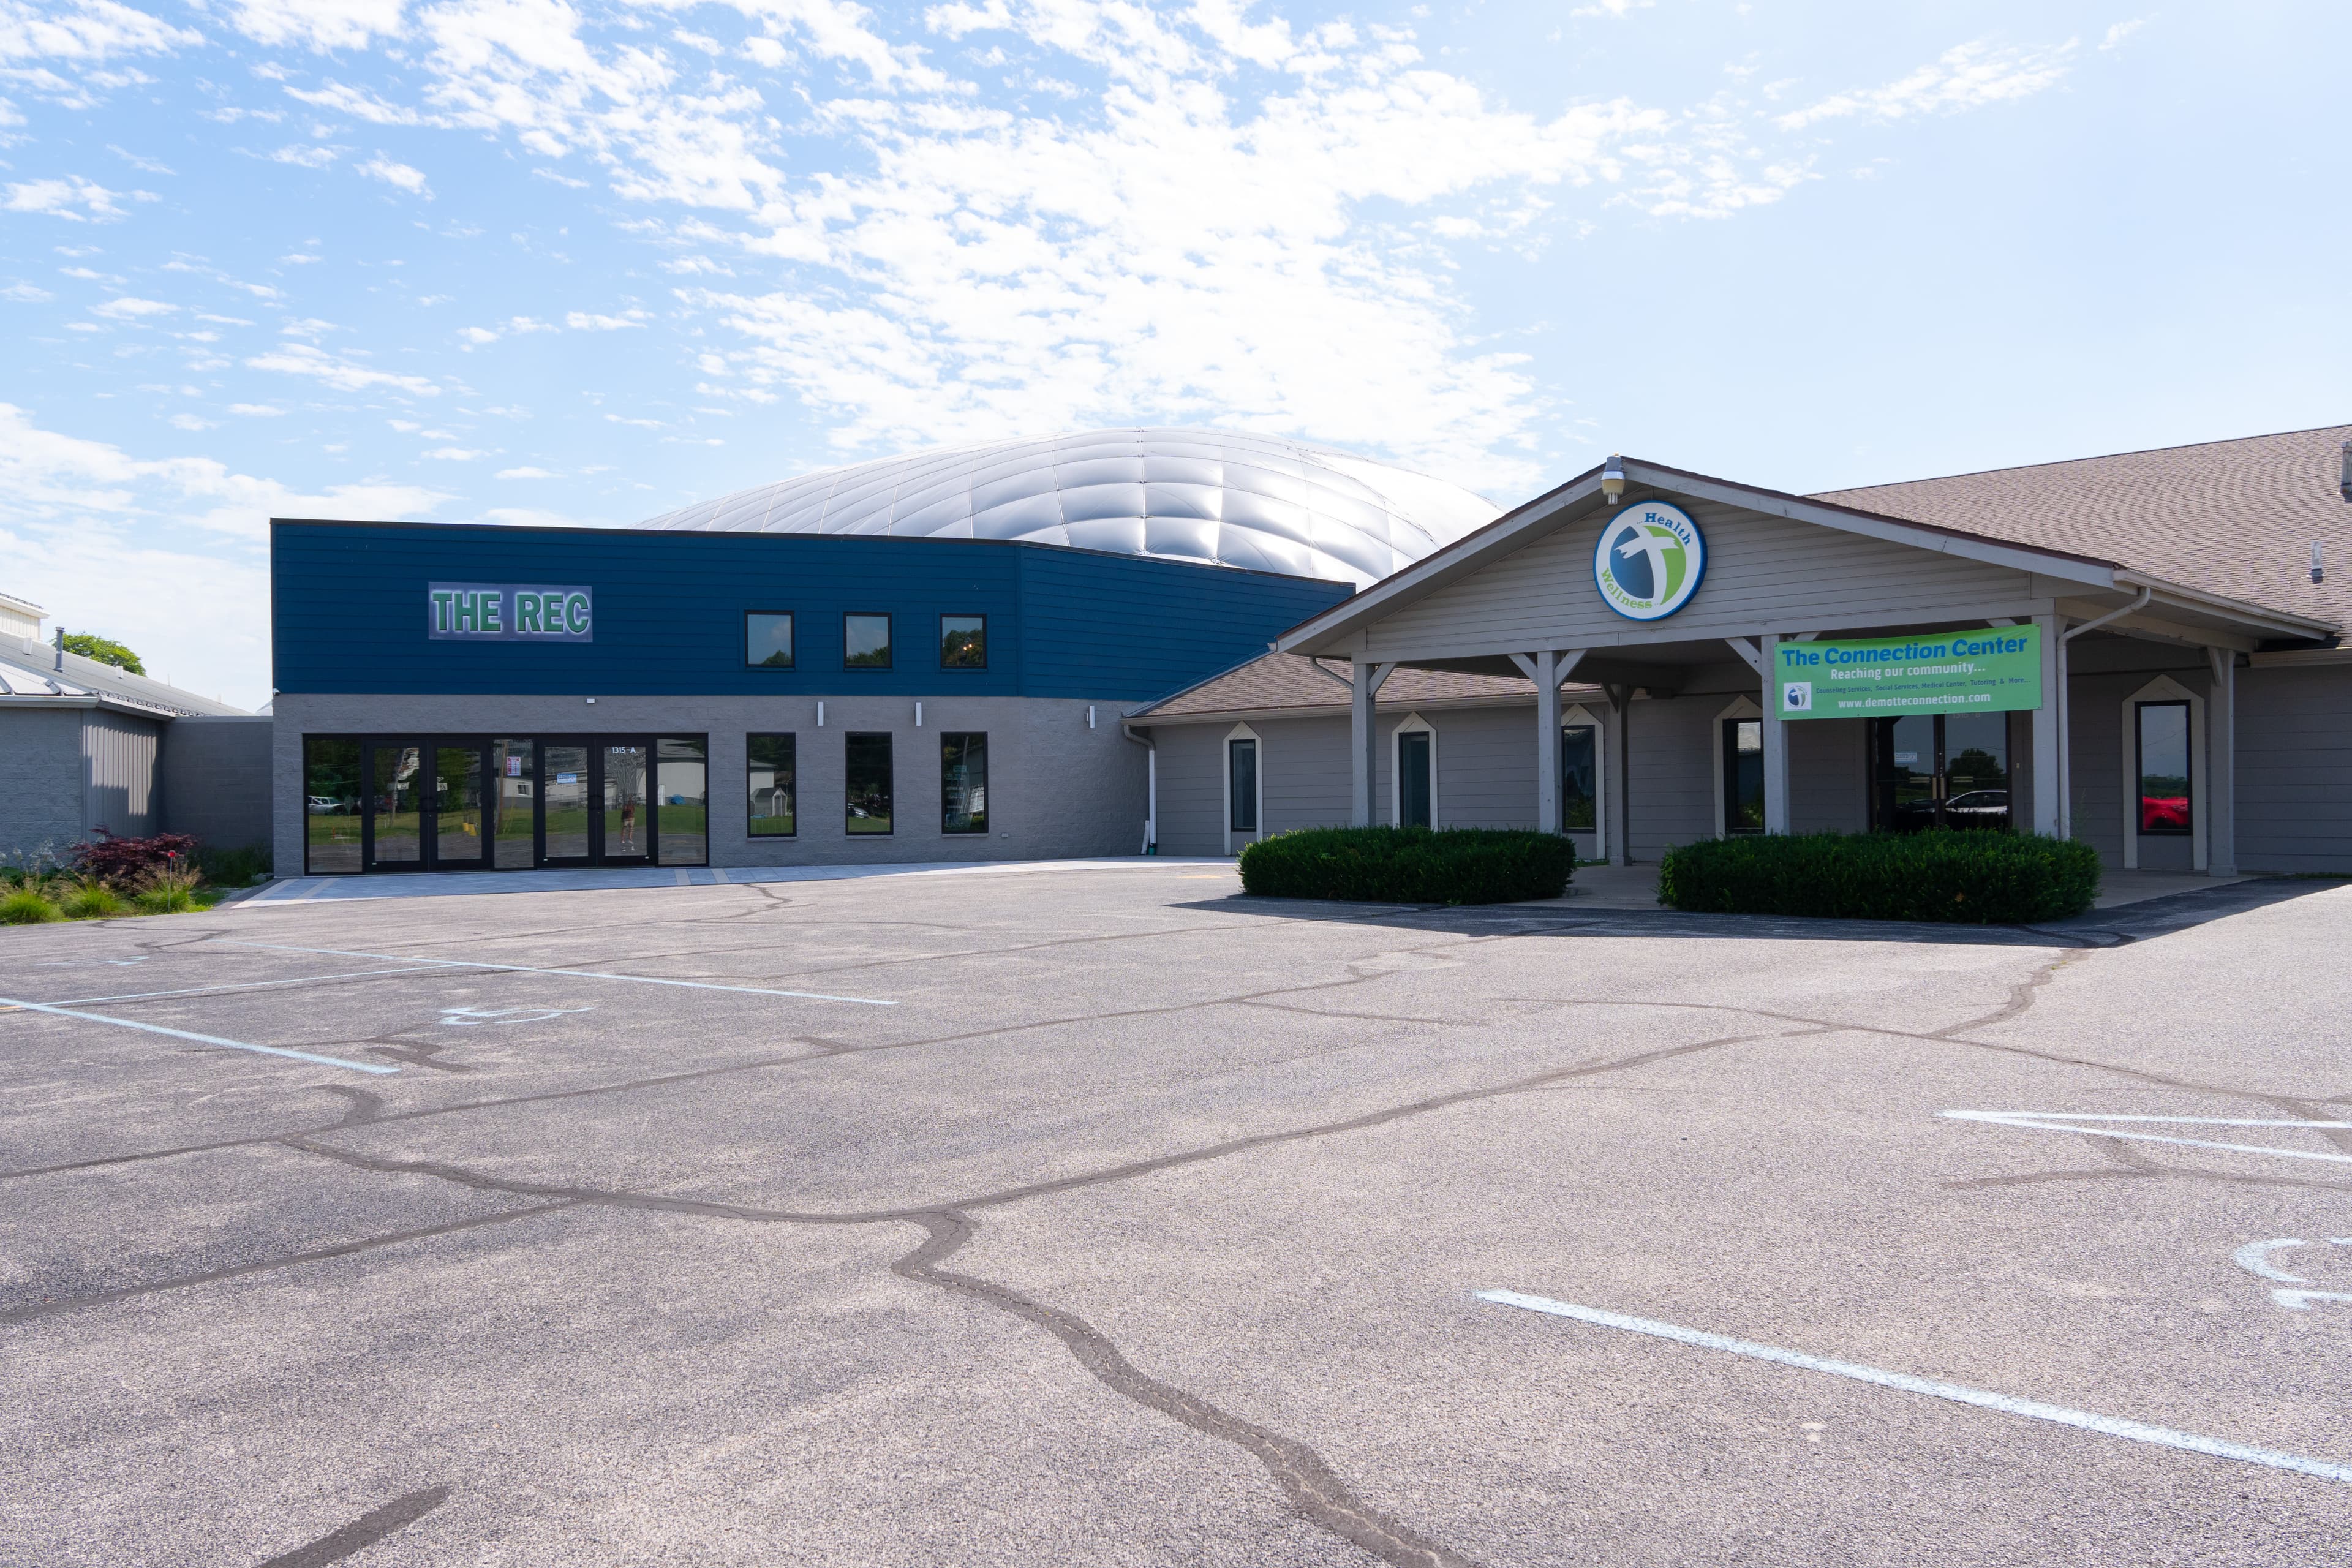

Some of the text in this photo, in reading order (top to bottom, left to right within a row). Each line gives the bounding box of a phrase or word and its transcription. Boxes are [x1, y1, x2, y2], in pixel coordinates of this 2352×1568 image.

[432, 592, 589, 633] THE REC
[1782, 636, 2028, 666] The Connection Center
[1830, 661, 1986, 680] Reaching our community...
[1838, 693, 1990, 708] www.demotteconnection.com
